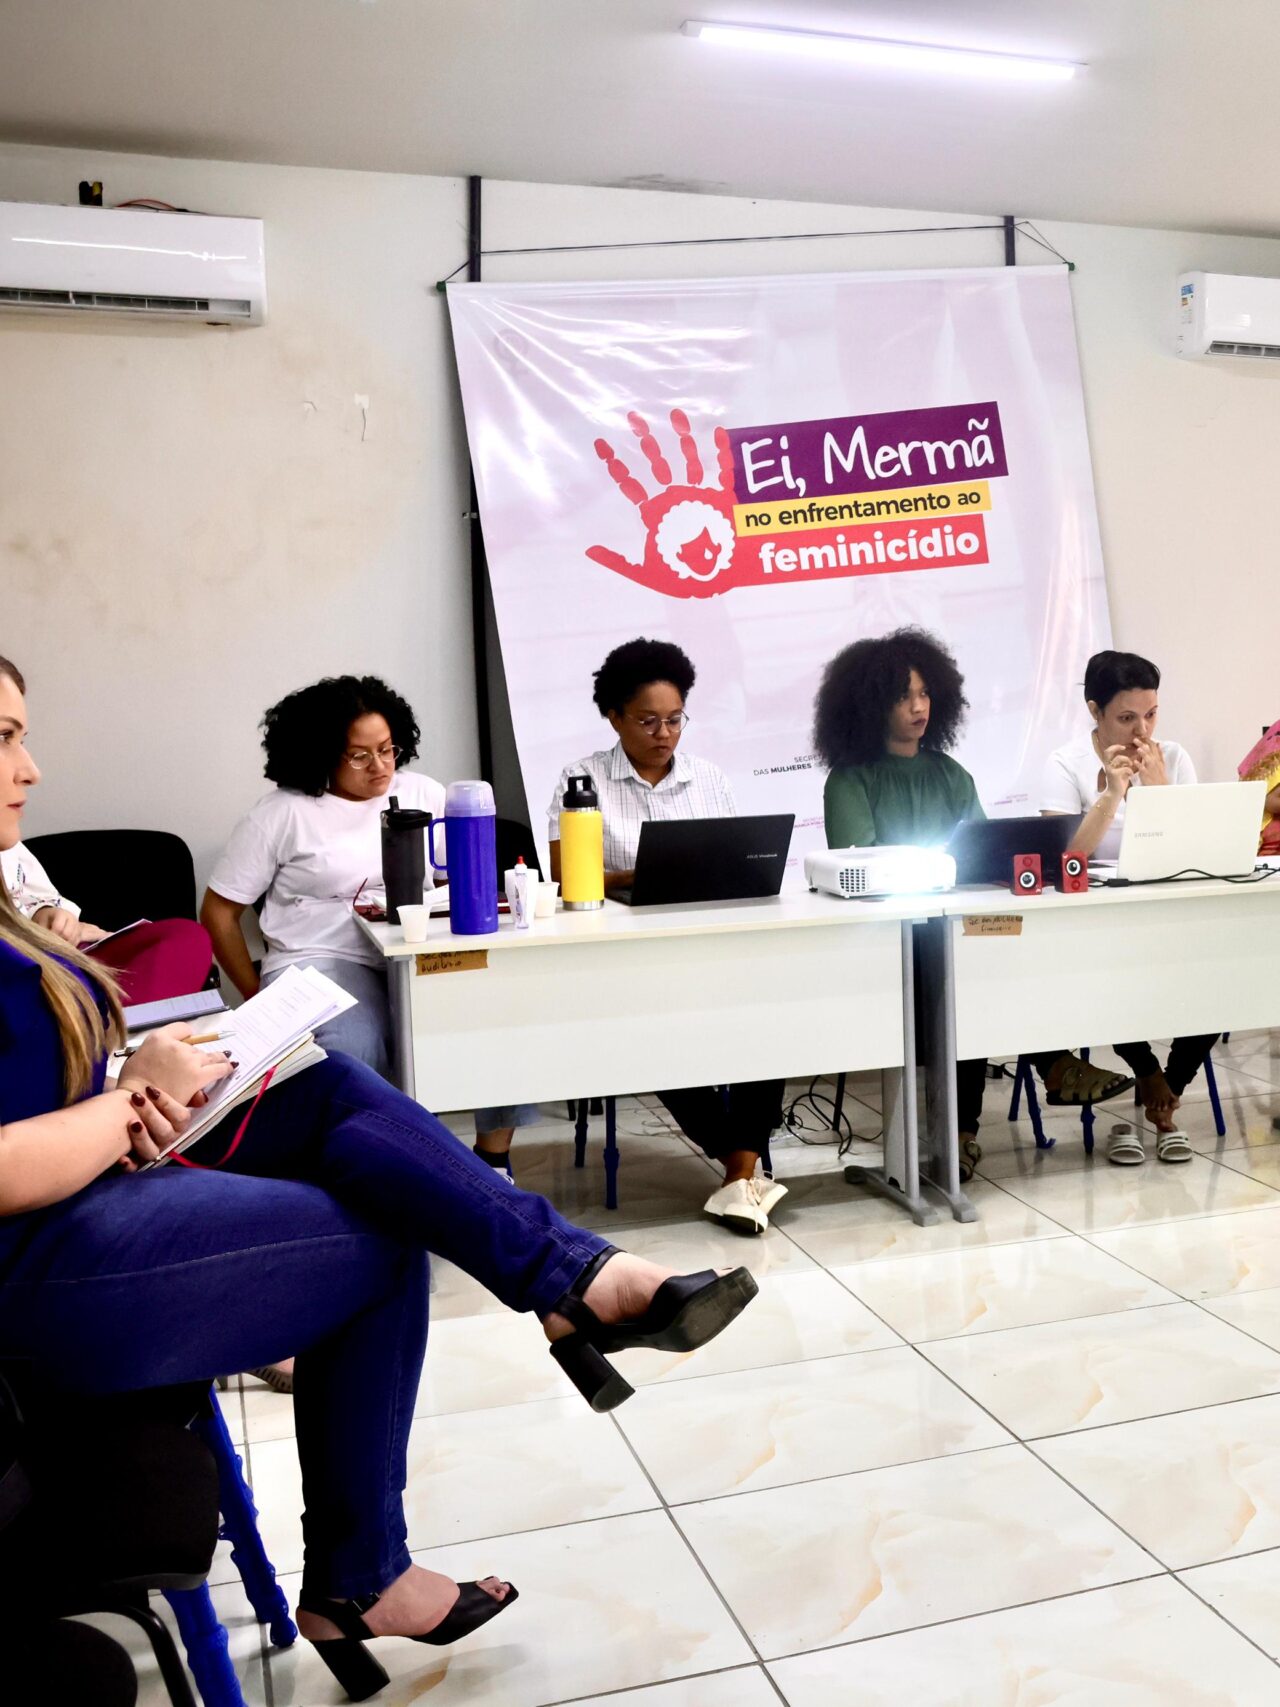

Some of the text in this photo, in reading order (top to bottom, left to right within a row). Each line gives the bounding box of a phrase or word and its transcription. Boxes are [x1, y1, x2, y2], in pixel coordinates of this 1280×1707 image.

[741, 418, 994, 497] Ei, Mermã
[745, 491, 981, 527] no enfrentamento ao
[758, 525, 979, 574] feminicídio
[753, 763, 812, 777] DAS MULHERES
